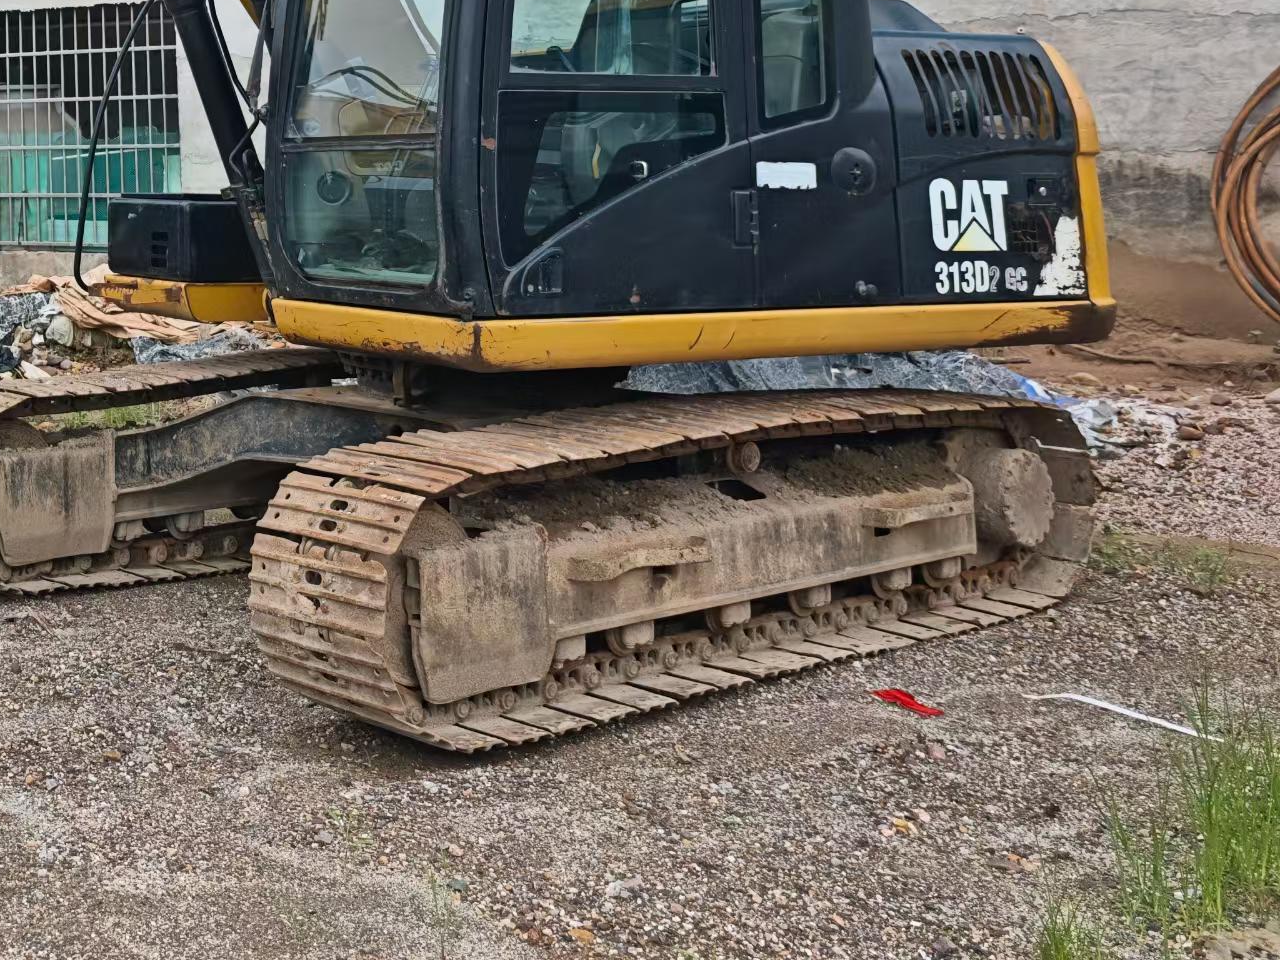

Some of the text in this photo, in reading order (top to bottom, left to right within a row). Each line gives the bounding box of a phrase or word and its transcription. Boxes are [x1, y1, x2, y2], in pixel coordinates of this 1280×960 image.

[928, 177, 1009, 252] CAT
[934, 260, 1028, 295] 313D2 GC
